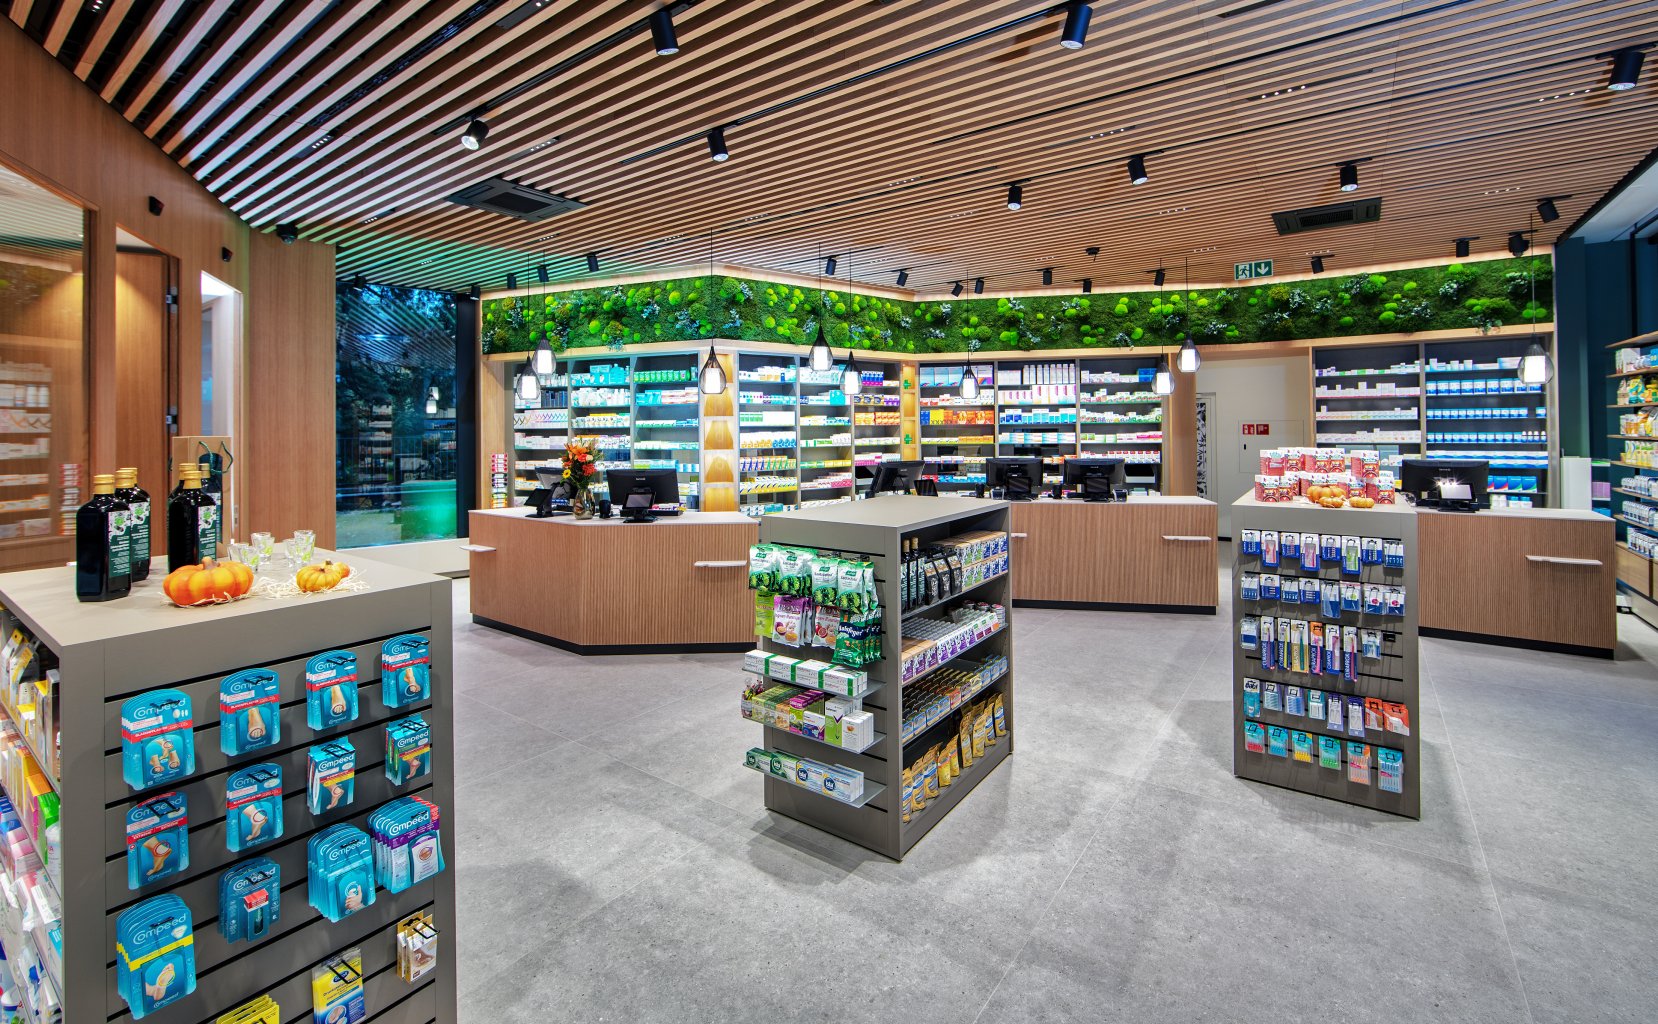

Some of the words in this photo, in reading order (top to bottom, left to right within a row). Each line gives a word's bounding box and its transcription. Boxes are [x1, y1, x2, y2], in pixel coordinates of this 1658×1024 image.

[397, 730, 429, 748] Compeed
[318, 754, 355, 771] Compeed
[390, 810, 429, 836] Compeed
[328, 837, 368, 861] Compeed
[132, 913, 187, 945] Compeed
